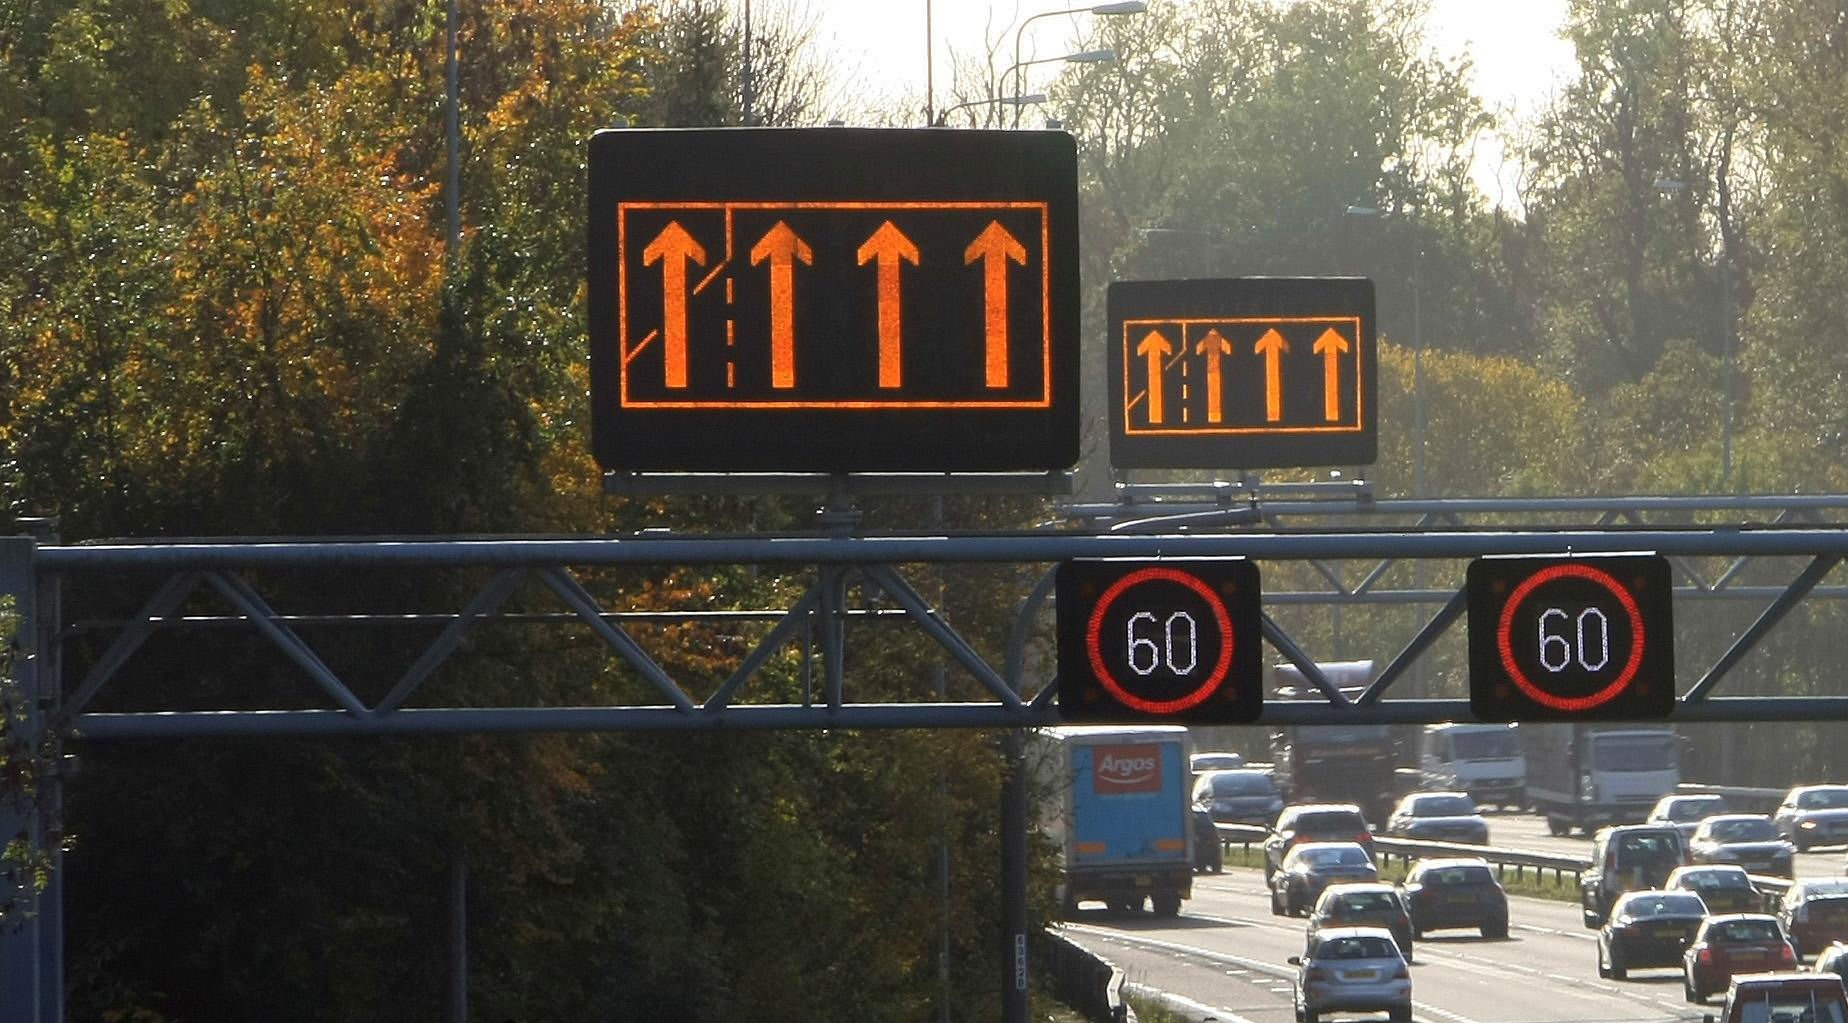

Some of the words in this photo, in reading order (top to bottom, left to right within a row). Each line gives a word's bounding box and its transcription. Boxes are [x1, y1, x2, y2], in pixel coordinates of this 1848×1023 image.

[1128, 612, 1197, 675] 60
[1539, 608, 1609, 672] 60
[1098, 754, 1156, 777] Argos
